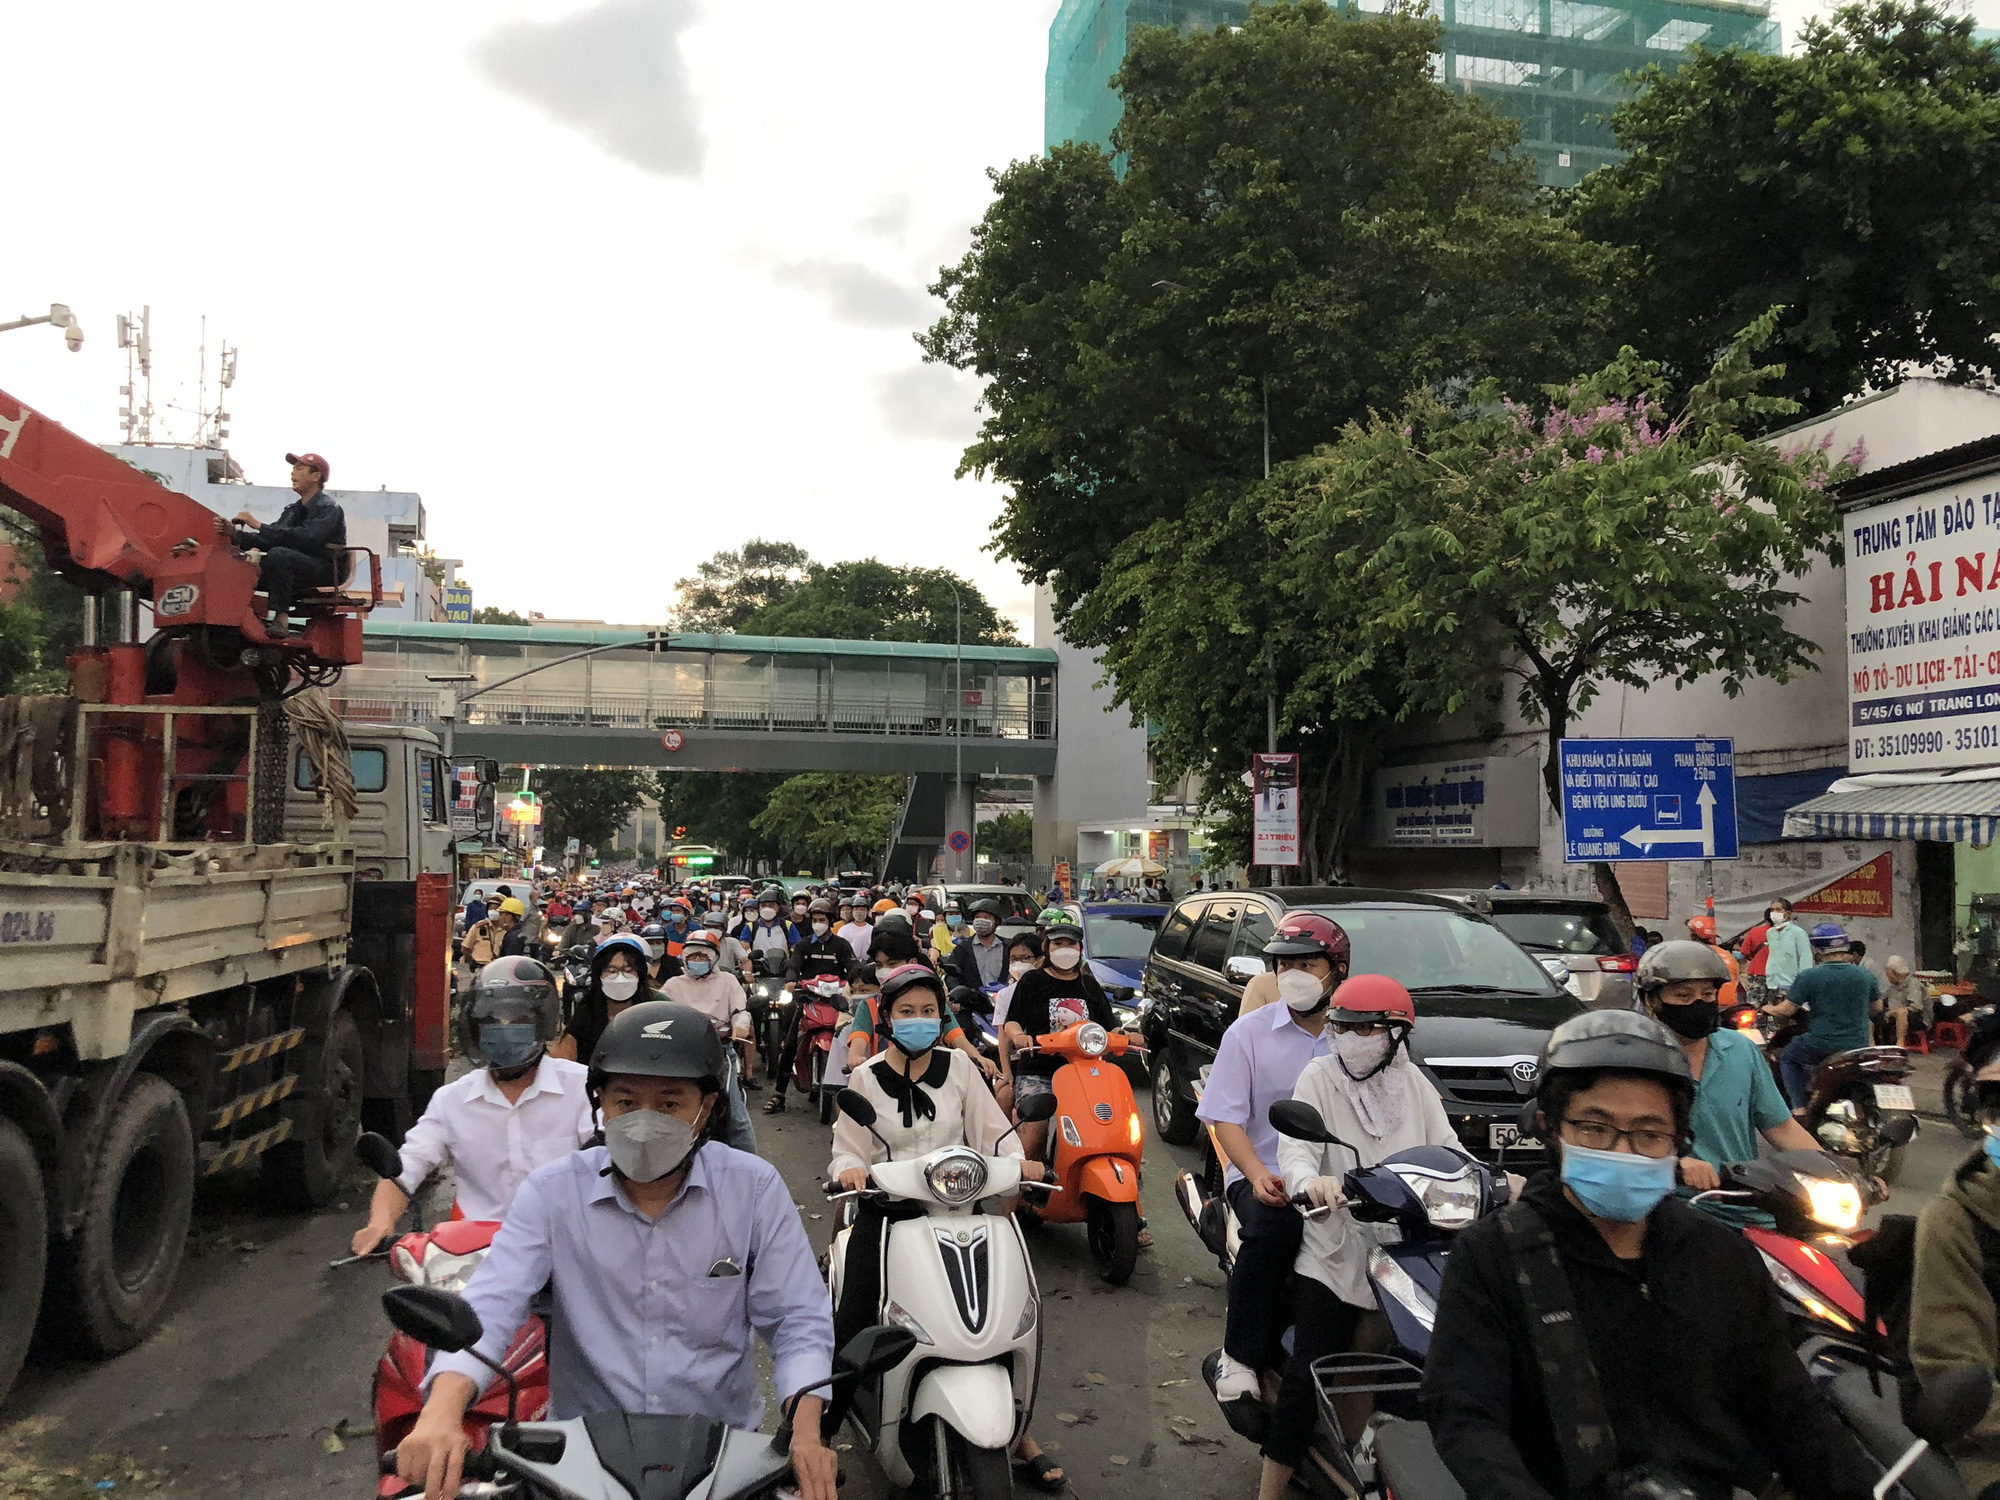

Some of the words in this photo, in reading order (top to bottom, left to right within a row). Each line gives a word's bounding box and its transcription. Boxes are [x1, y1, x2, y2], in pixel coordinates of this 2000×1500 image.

[1854, 517, 1900, 557] TRUNG
[1906, 506, 1937, 545] TÂM
[1944, 495, 1975, 536] ĐÀO
[1869, 550, 1943, 613] HẢI
[1851, 625, 1884, 654] THƯỜNG
[1886, 619, 1915, 649] XUYÊN
[1918, 618, 1940, 643] KHAI
[1943, 607, 1971, 639] GIẢNG
[1975, 605, 1993, 634] CÁC
[1853, 666, 1870, 694] MÔ
[1916, 658, 1946, 691] LỊCH
[1954, 645, 1977, 680] TẢI
[1860, 704, 1903, 720] 5/45/6
[1906, 700, 1925, 716] NƠ
[1929, 695, 1973, 713] TRANG
[1855, 737, 1874, 760] ĐT:
[1878, 730, 1943, 758] 35109990
[1955, 725, 1998, 751] 35101
[1566, 753, 1580, 768] KHU
[1632, 749, 1652, 767] ĐOÁN
[1674, 753, 1694, 767] PHAN
[1564, 770, 1575, 788] VÀ
[1575, 769, 1592, 788] ĐIỀU
[1593, 774, 1606, 790] TRỊ
[1618, 771, 1641, 790] THUẬT
[1643, 774, 1659, 788] CAO
[1693, 767, 1716, 780] 250m
[1572, 792, 1591, 811] BỆNH
[1592, 792, 1609, 811] VIỆN
[1610, 794, 1626, 808] UNG
[1270, 833, 1296, 842] TRIỆU
[1280, 845, 1294, 853] 0%
[1567, 840, 1576, 856] LÊ
[1577, 842, 1602, 857] QUANG
[1603, 842, 1621, 858] ĐỊNH
